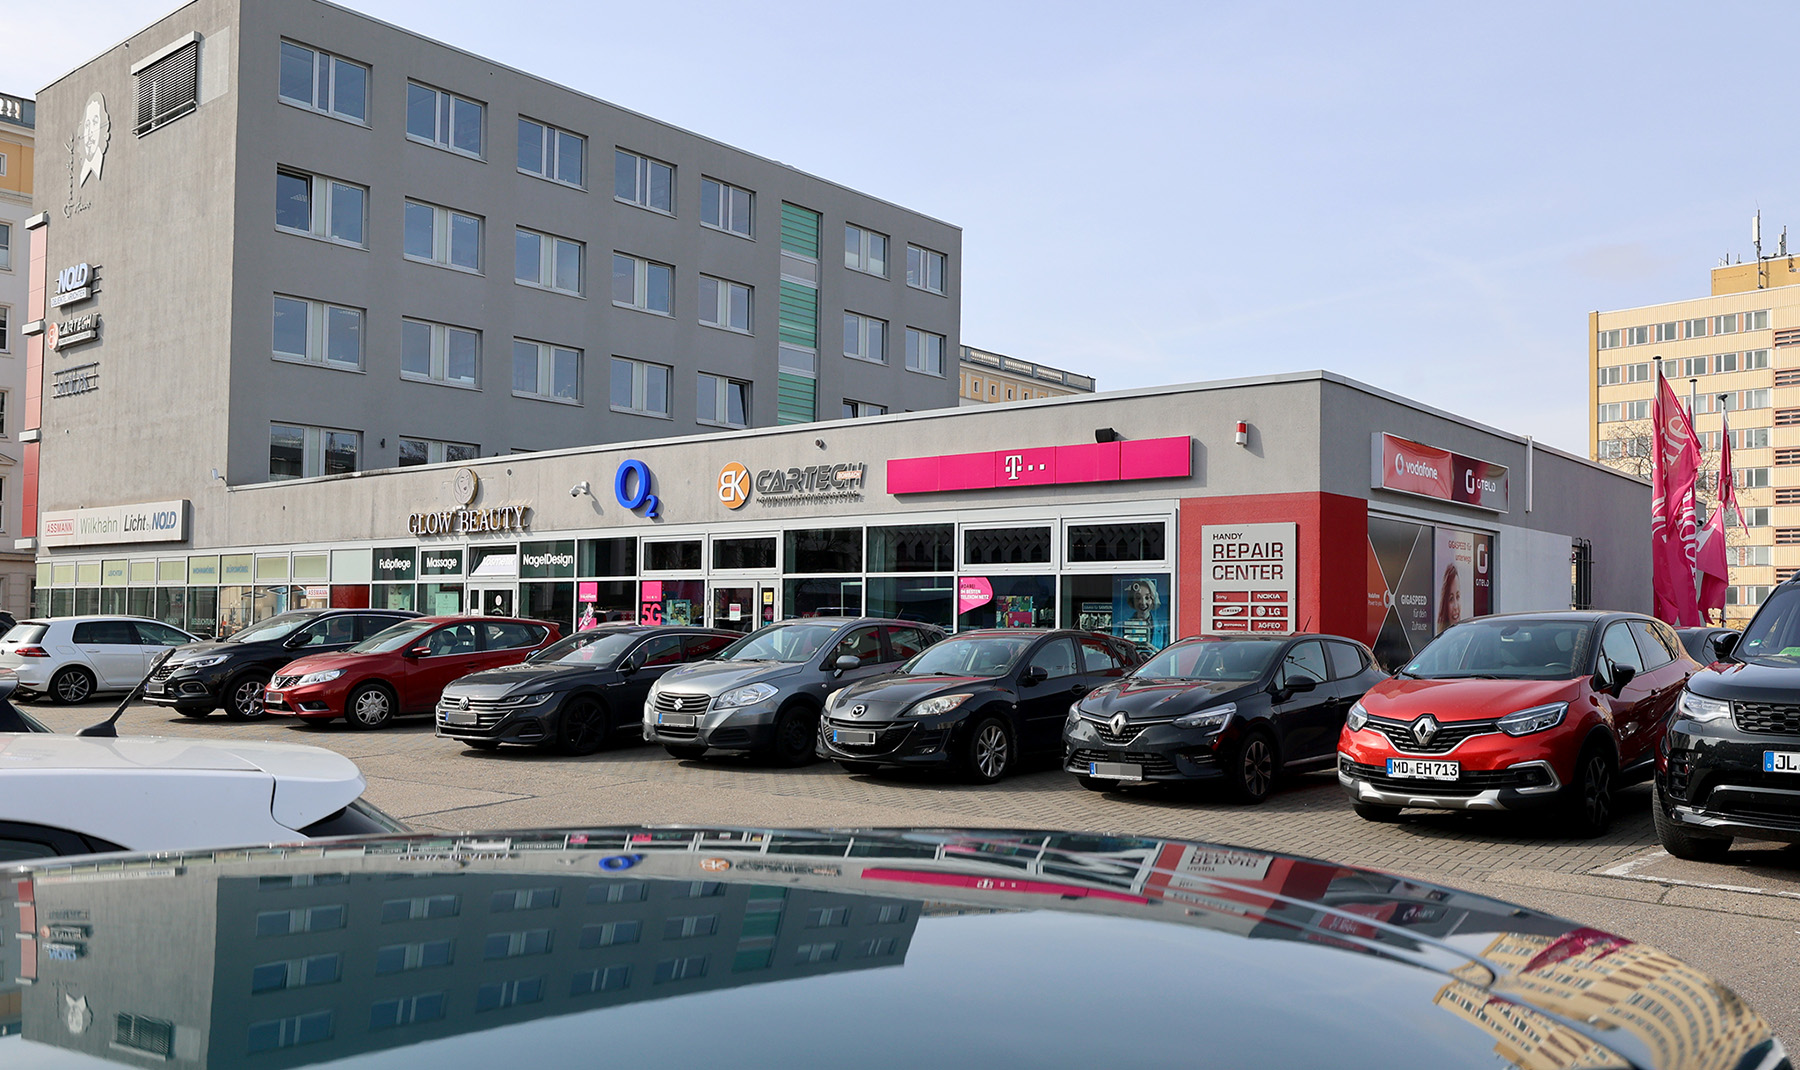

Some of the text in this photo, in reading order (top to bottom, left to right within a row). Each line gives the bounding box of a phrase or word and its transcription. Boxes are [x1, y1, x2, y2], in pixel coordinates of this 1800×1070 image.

[57, 263, 89, 294] NOLD
[1405, 461, 1438, 479] vodafone
[755, 462, 863, 494] CARTECH
[47, 521, 74, 534] ASSMANN
[80, 518, 118, 535] Wilkhahn
[123, 514, 147, 532] Licht
[151, 511, 177, 531] NOLD
[408, 506, 527, 534] GLOW BEAUTY
[1213, 542, 1284, 559] REPAIR
[379, 558, 411, 571] Fußpflege
[426, 557, 457, 572] Massage
[522, 553, 573, 568] NagelDesign
[1213, 564, 1284, 580] CENTER
[1401, 594, 1427, 605] GIGASPEED
[641, 603, 663, 624] 5G
[1269, 607, 1281, 616] LG
[1411, 621, 1427, 631] Zuhause
[1393, 761, 1457, 776] MD EH 713
[1775, 755, 1797, 770] JL
